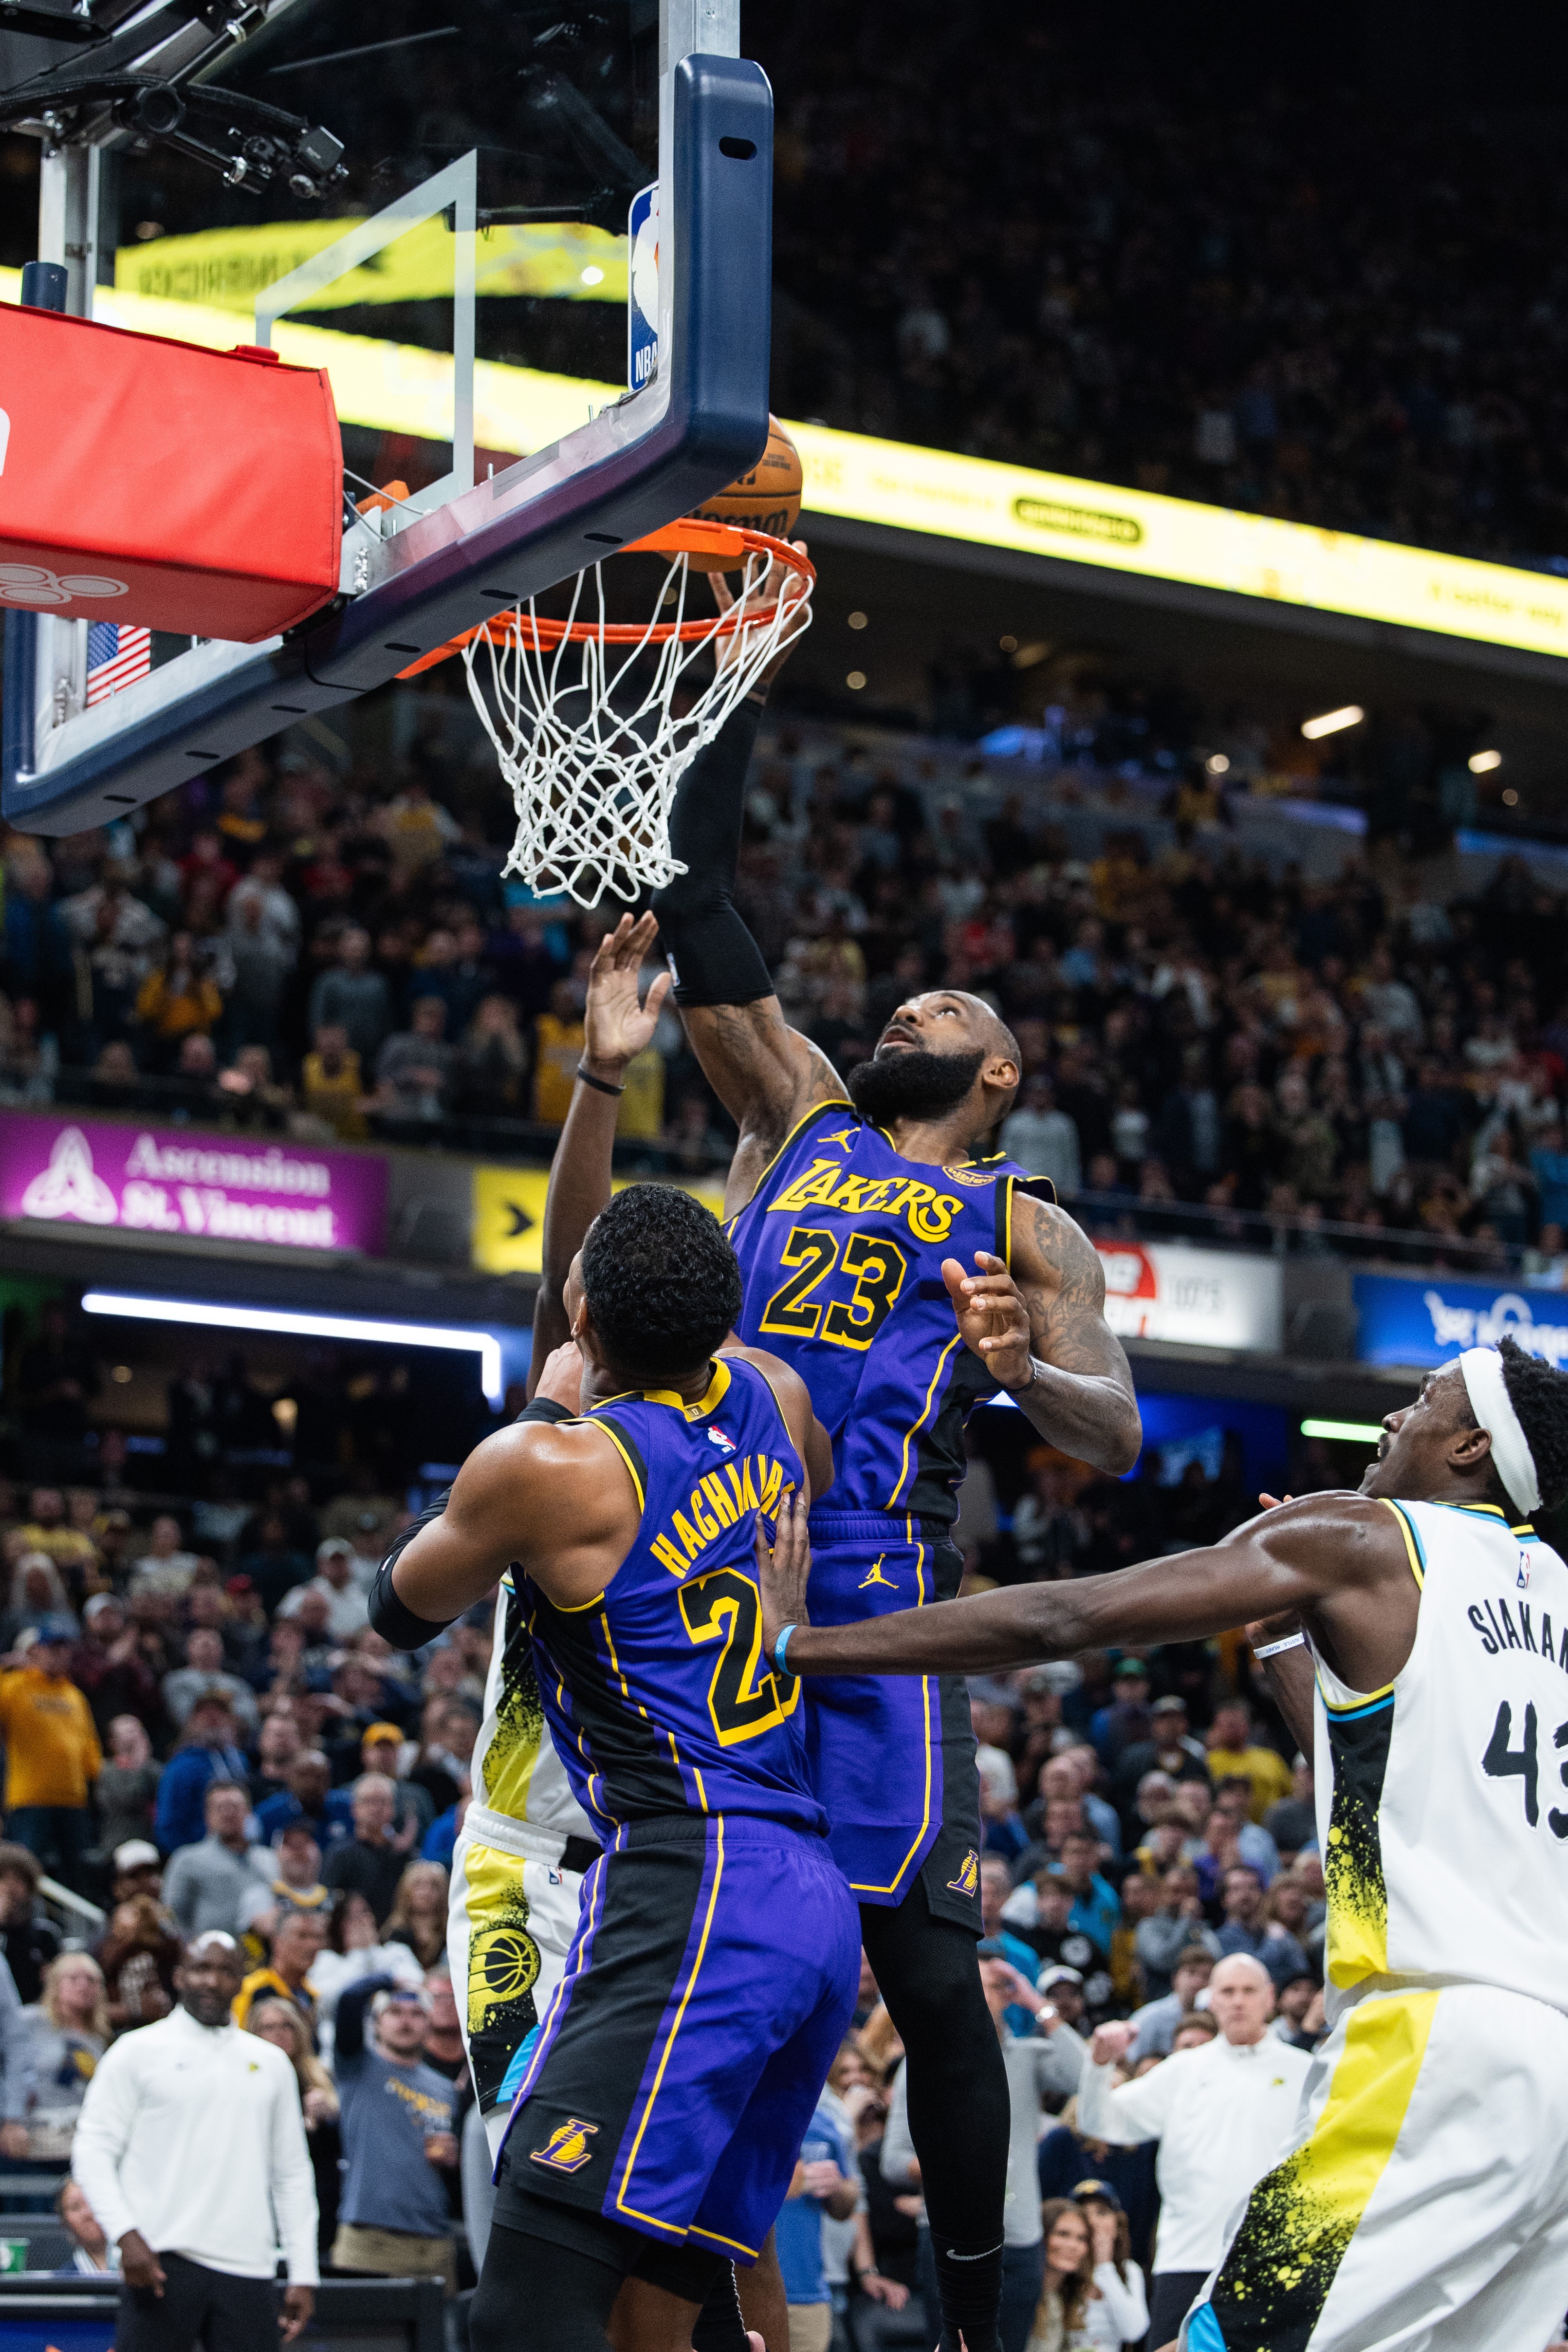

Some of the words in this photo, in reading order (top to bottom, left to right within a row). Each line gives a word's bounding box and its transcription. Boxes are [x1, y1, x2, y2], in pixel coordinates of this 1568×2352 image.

[126, 1133, 330, 1197] Ascension
[178, 1185, 334, 1247] Vincent
[766, 1158, 964, 1243] LAKERS
[758, 1226, 907, 1351] 23
[650, 1453, 795, 1579] HACHIR
[677, 1566, 801, 1747] 2
